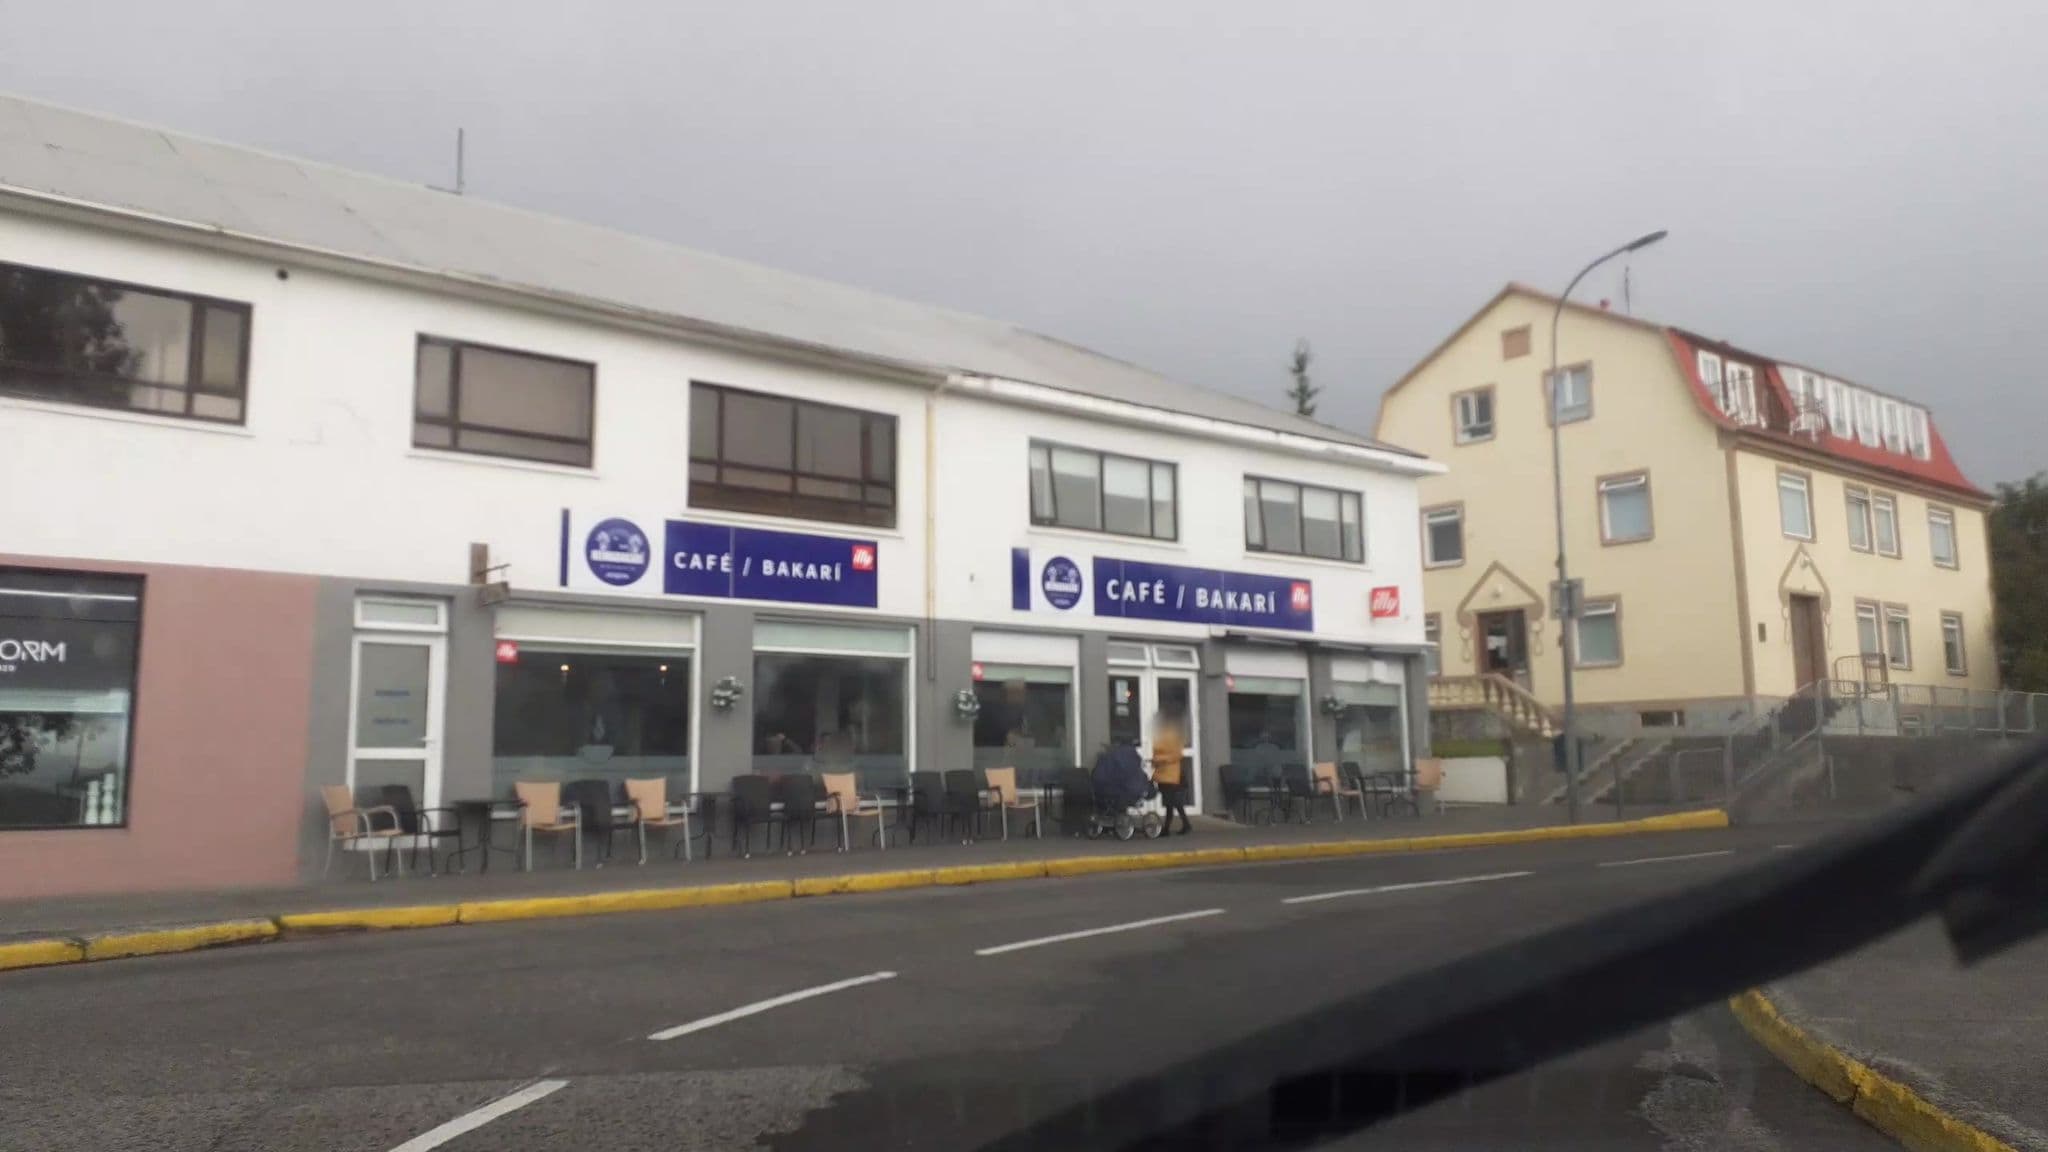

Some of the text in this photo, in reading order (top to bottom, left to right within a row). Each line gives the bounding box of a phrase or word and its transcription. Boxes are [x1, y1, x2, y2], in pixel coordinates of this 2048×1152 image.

[674, 551, 732, 573] CAFÉ
[762, 559, 841, 582] BAKARÍ
[1106, 579, 1165, 604] CAFÉ
[1195, 588, 1275, 614] BAKARÍ
[1373, 591, 1399, 615] illy
